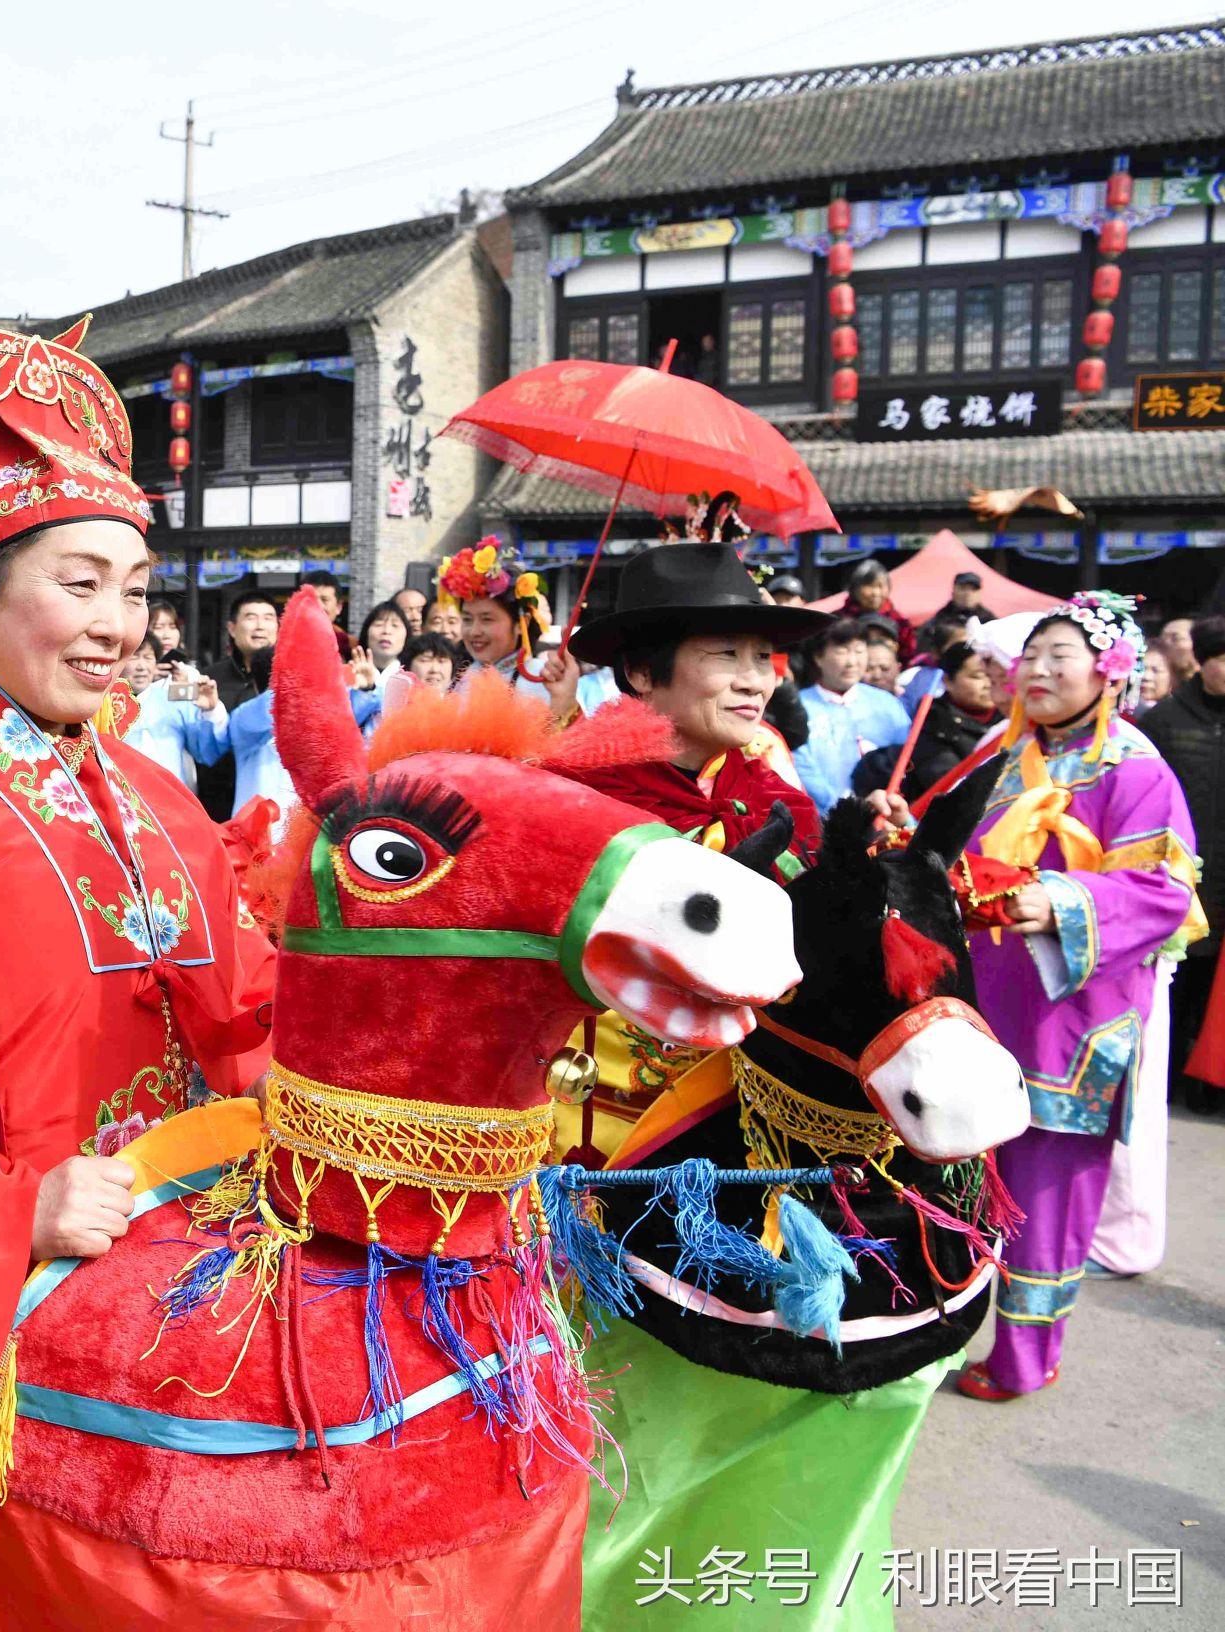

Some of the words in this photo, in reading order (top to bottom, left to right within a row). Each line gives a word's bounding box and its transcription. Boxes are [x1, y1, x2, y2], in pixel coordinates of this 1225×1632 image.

[878, 391, 1037, 431] 马家烧饼
[1142, 383, 1225, 418] 柴家
